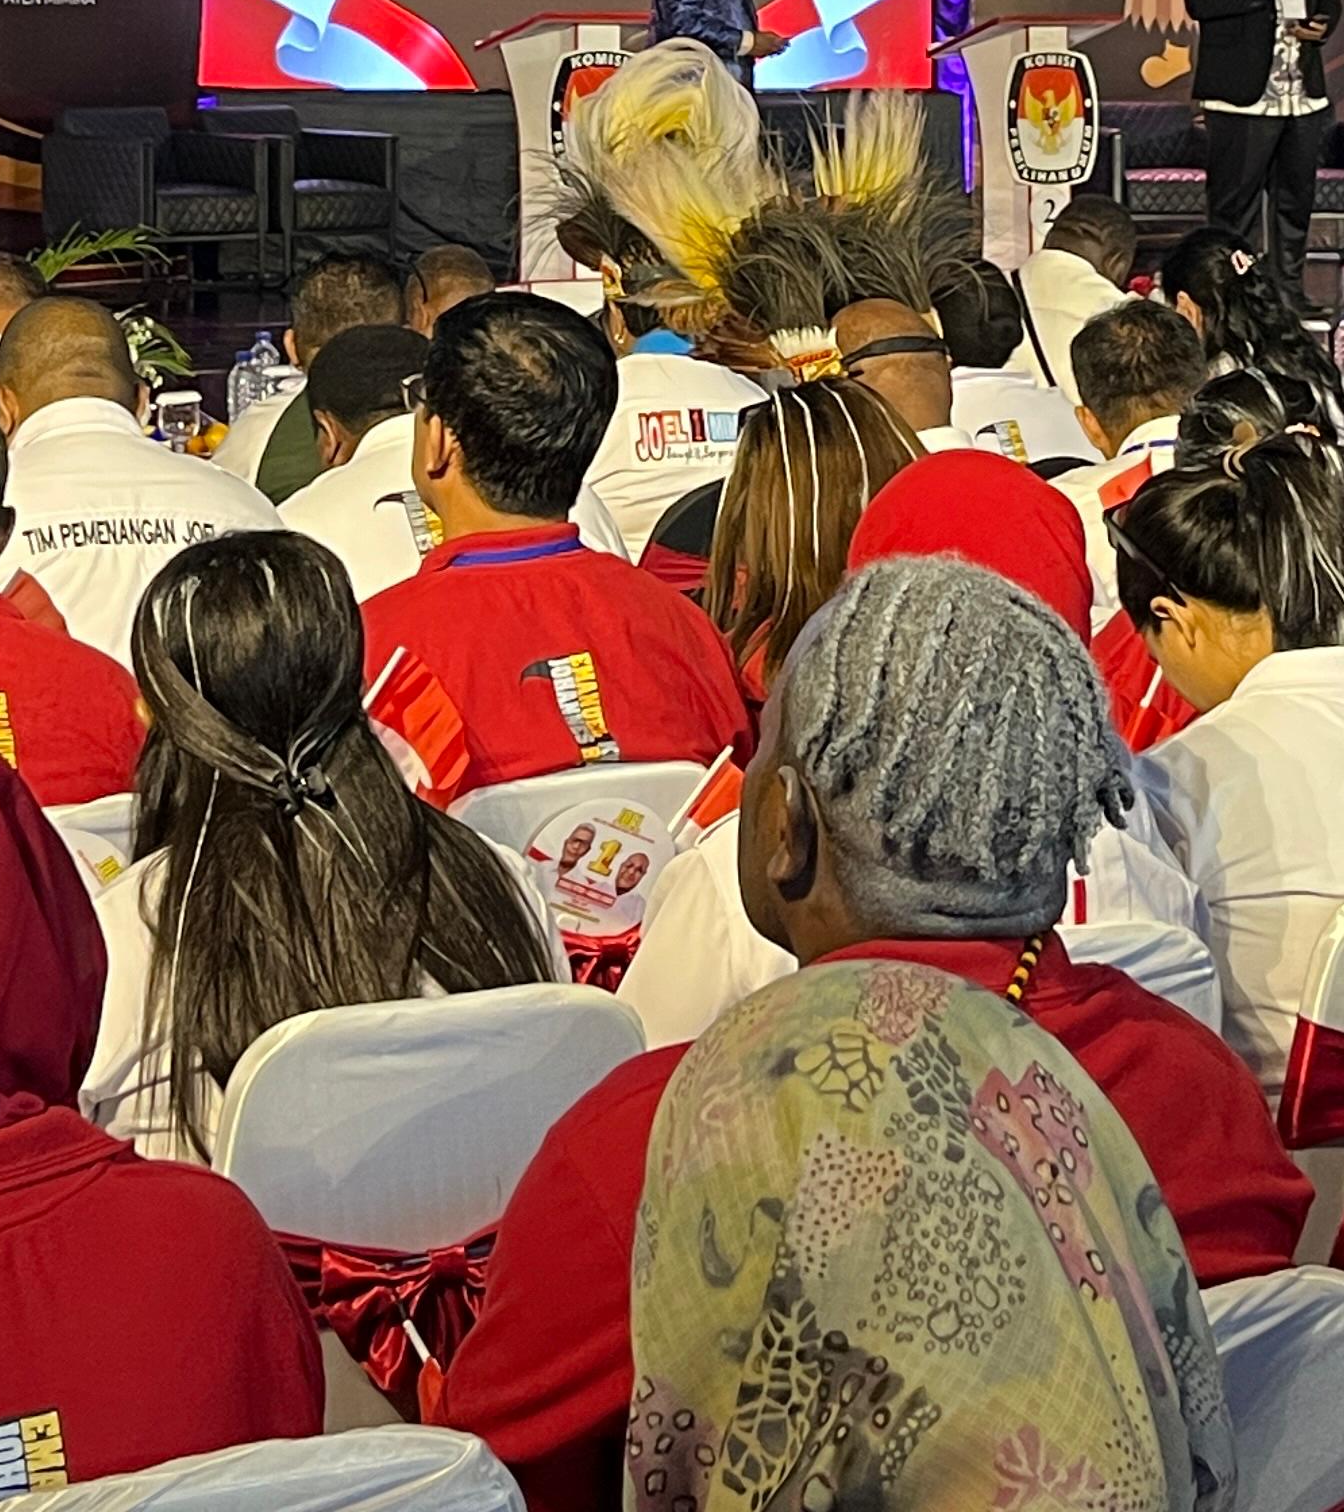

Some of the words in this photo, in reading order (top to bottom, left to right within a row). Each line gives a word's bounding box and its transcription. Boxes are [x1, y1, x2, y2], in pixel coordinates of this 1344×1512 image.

[1024, 53, 1076, 69] KOMISI
[1043, 199, 1055, 223] 2
[636, 410, 689, 462] JOEL
[22, 525, 58, 555] TIM
[59, 518, 177, 548] PEMENANGAN
[587, 839, 622, 877] 1
